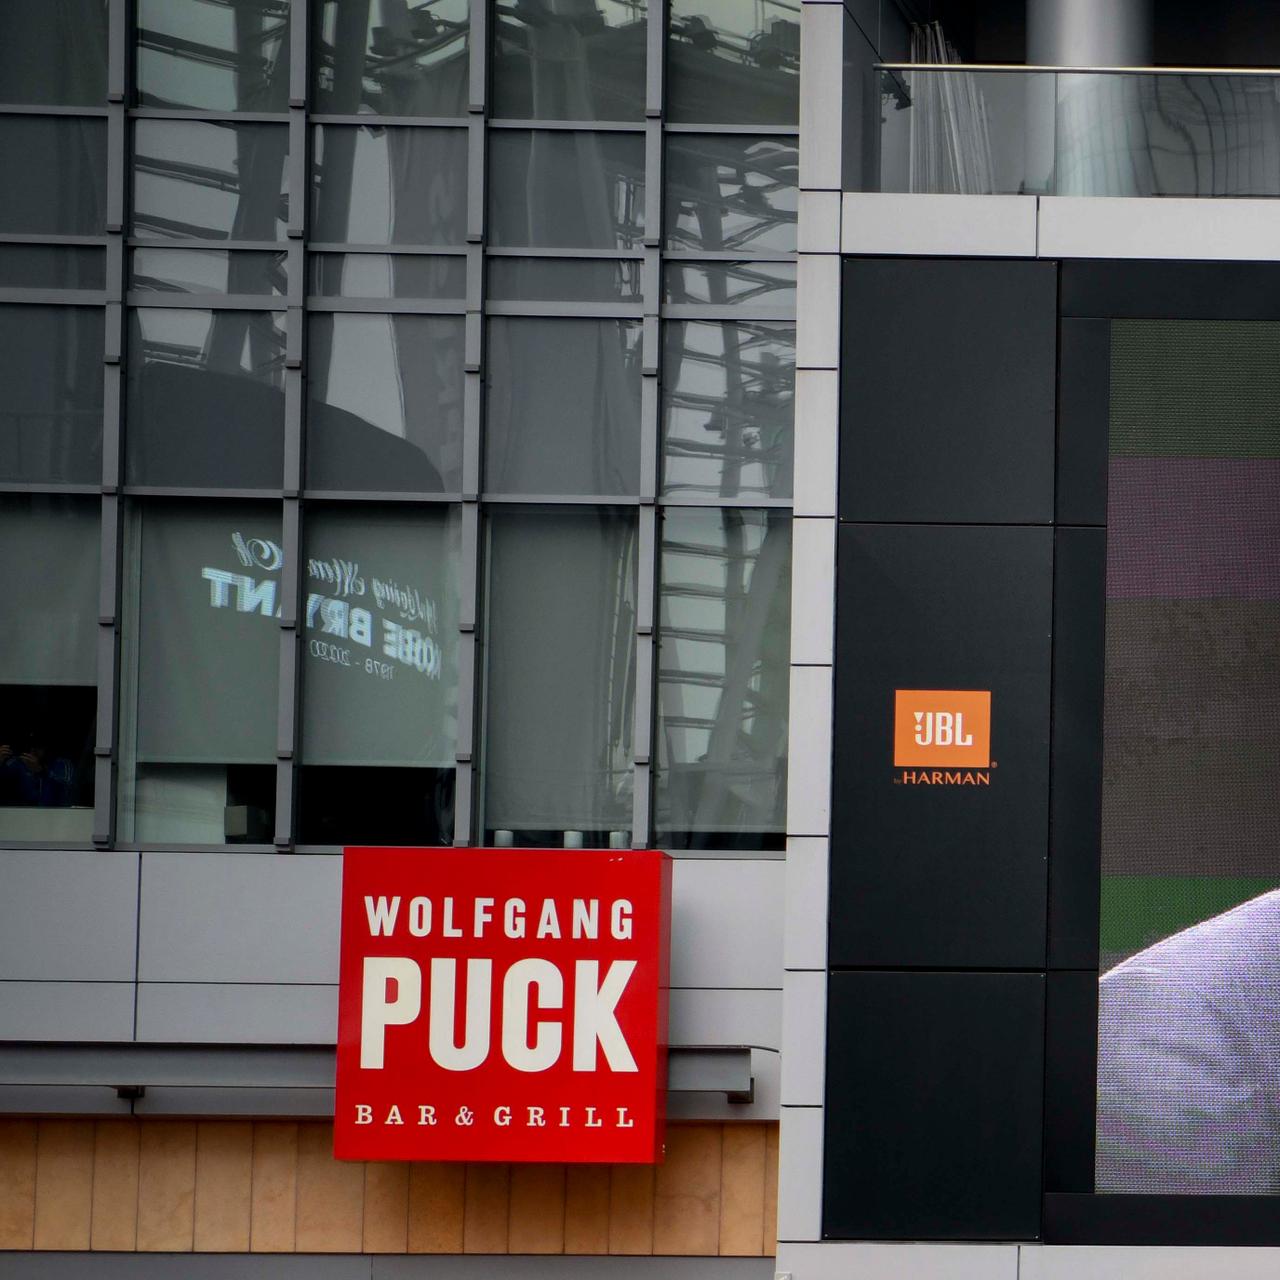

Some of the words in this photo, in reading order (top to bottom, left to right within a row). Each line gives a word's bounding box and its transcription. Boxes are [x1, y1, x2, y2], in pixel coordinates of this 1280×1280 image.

[913, 711, 973, 746] JBL
[903, 771, 990, 785] HARMAN
[364, 895, 634, 940] WOLFGANG
[359, 957, 640, 1073] PUCK
[354, 1104, 437, 1126] BAR
[454, 1106, 474, 1127] &
[493, 1106, 634, 1128] GRILL
